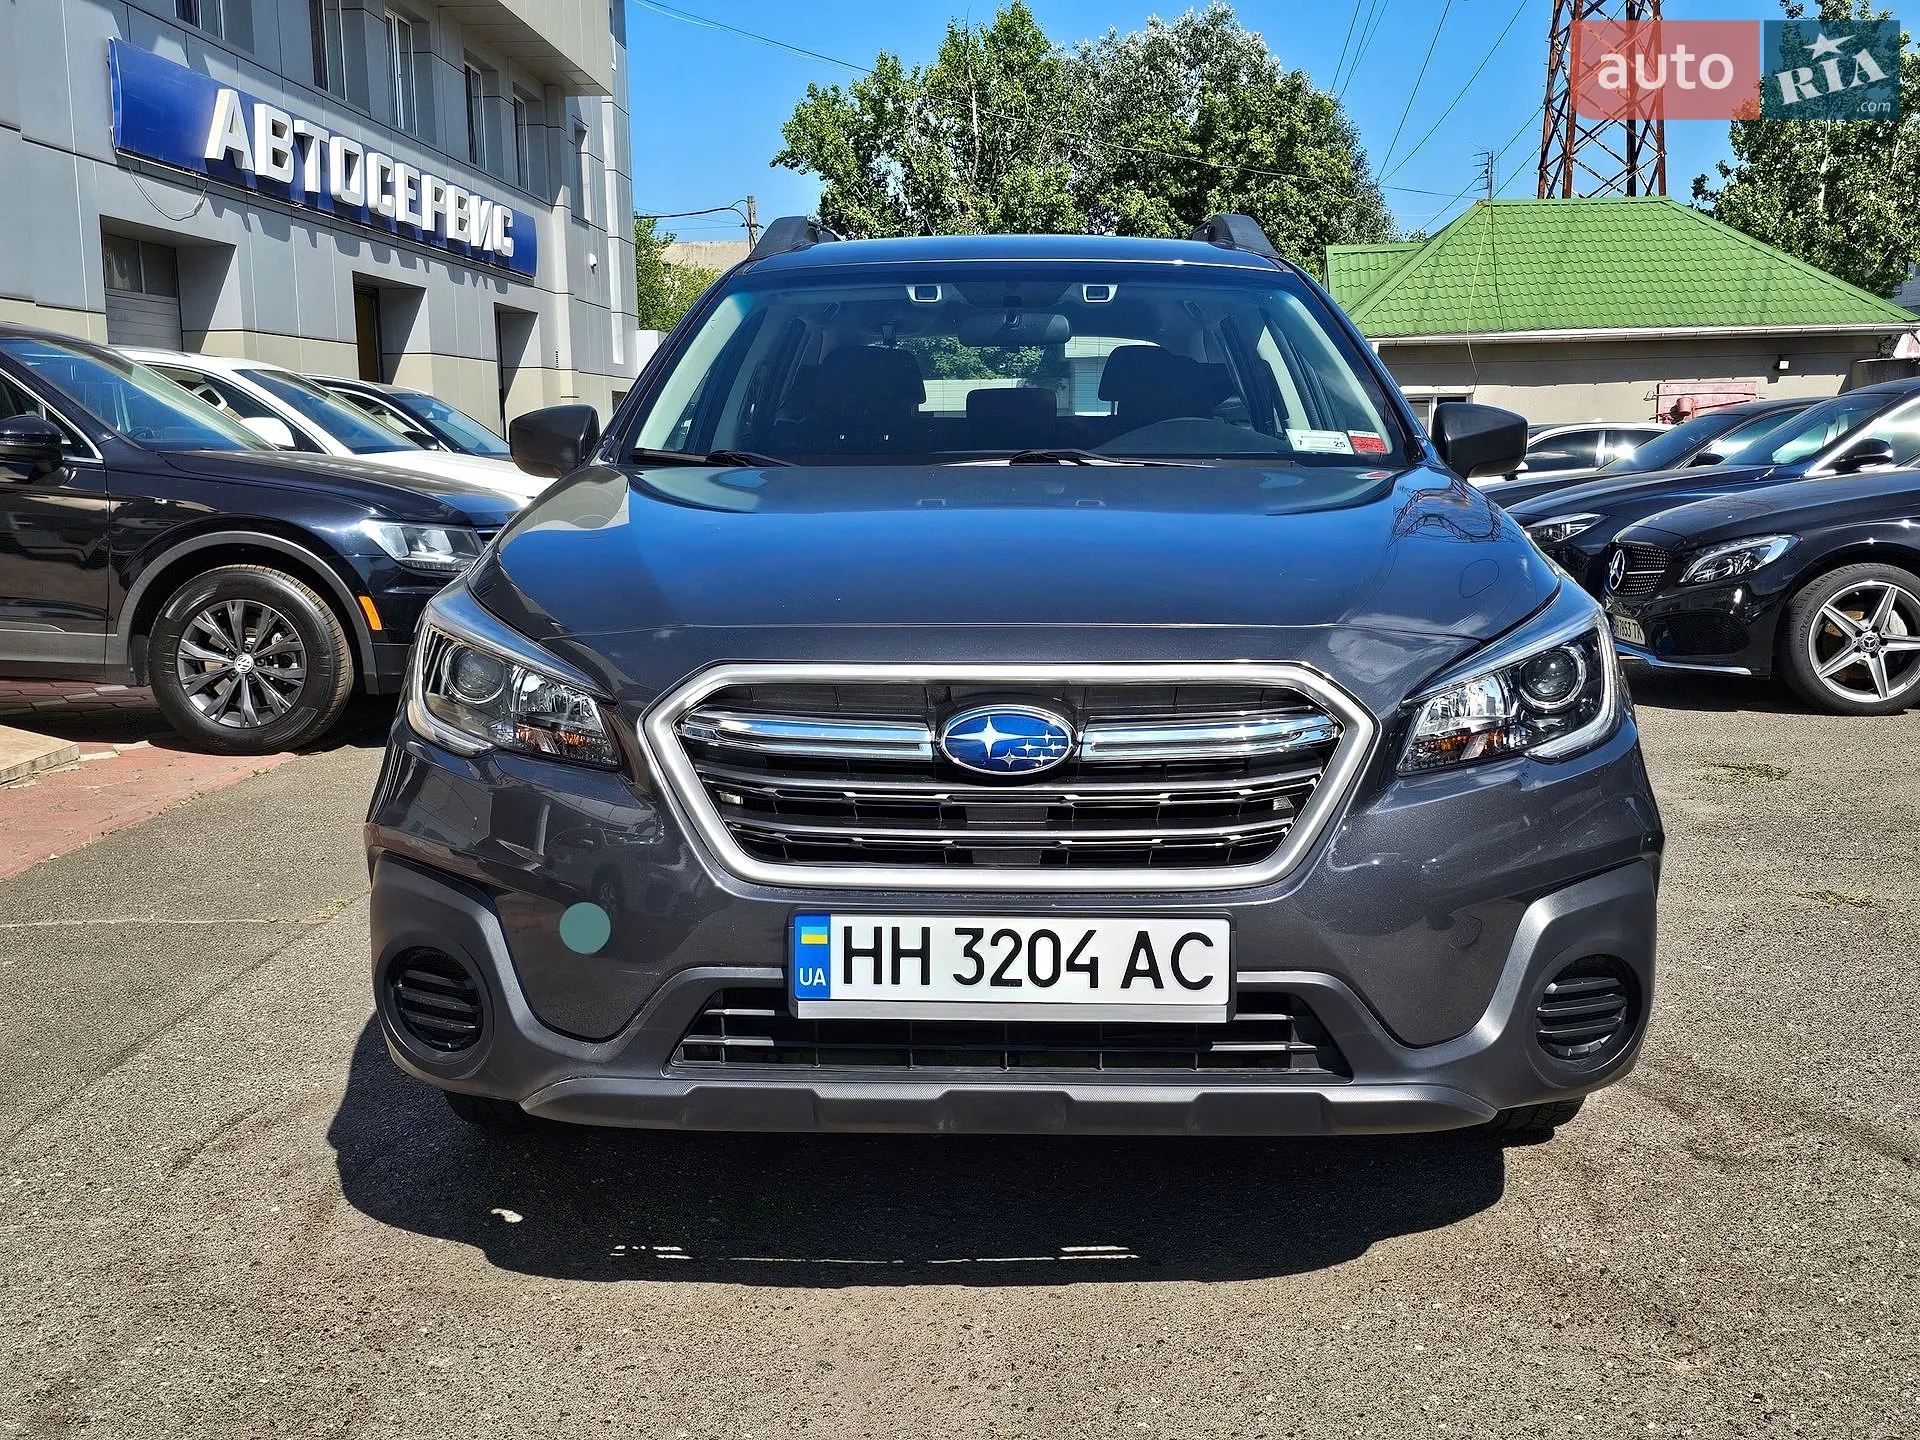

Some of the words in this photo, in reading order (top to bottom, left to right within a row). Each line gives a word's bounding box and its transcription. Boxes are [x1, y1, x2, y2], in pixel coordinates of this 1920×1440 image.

[204, 88, 515, 257] АВТОСЕРВИС
[1333, 440, 1346, 448] 25
[800, 967, 826, 986] UA
[844, 926, 931, 985] HH
[953, 928, 1099, 988] 3204
[1120, 930, 1214, 990] AC
